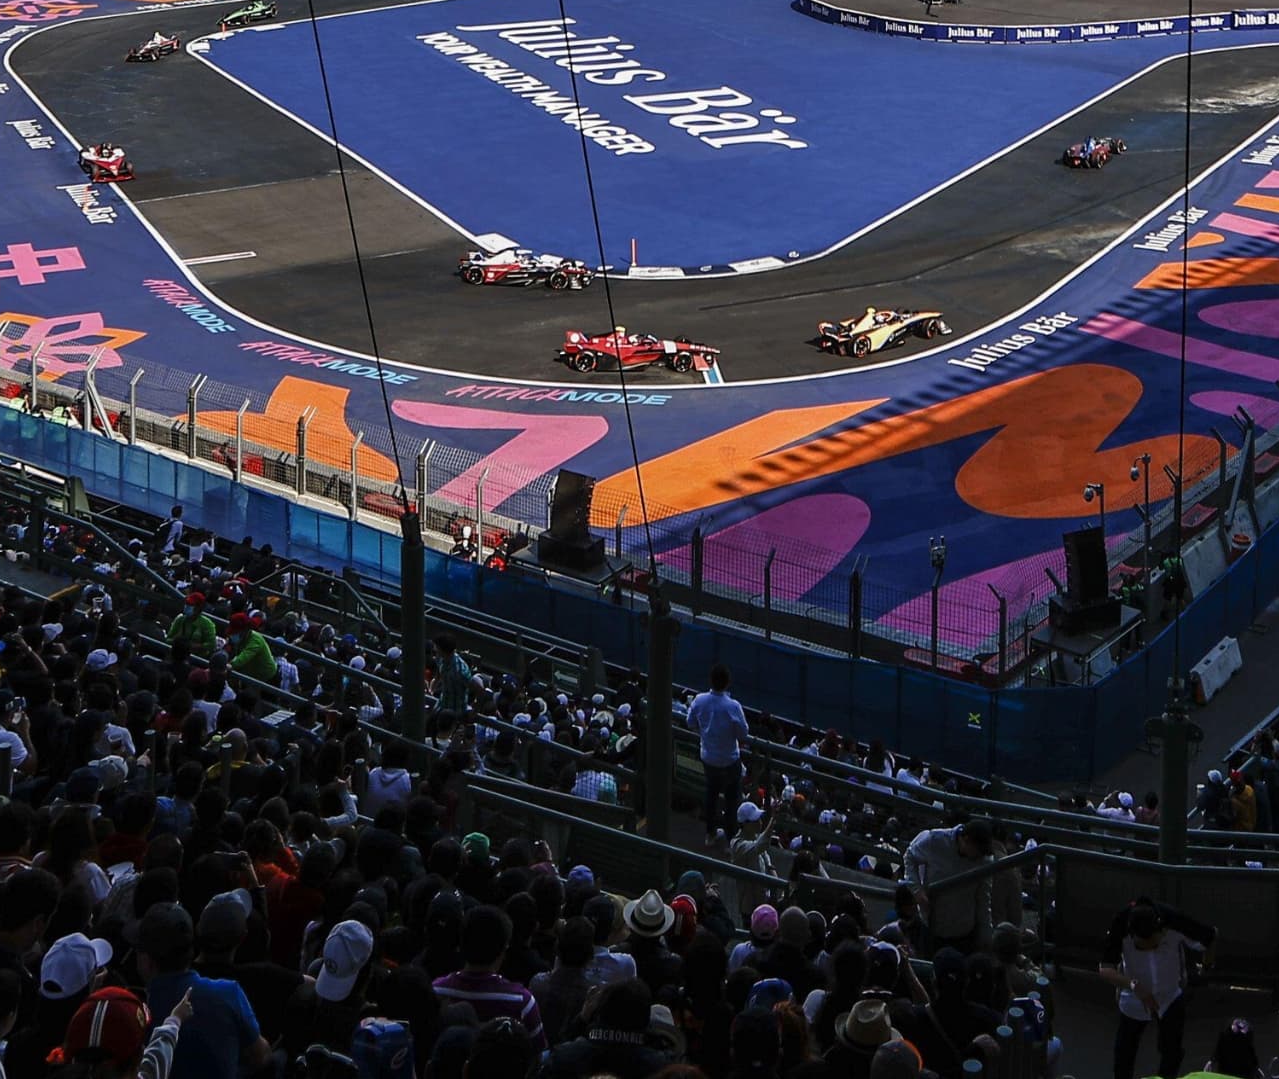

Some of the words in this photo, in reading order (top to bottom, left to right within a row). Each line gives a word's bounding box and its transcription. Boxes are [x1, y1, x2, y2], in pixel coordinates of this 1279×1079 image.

[884, 21, 907, 32] Julius
[908, 23, 924, 33] Bär
[1137, 23, 1158, 33] Julius
[1157, 19, 1174, 29] Bär
[1233, 14, 1265, 26] Julius
[947, 28, 973, 37] Julius
[973, 29, 994, 37] Bär
[1016, 27, 1041, 39] Julius
[1042, 29, 1061, 37] Bär
[1080, 27, 1103, 37] Julius
[1102, 23, 1120, 33] Bär
[455, 17, 666, 85] Julius
[622, 85, 809, 150] Bär
[415, 31, 481, 56] YOUR
[456, 52, 552, 98] WEALTH
[522, 89, 656, 156] MANAGER
[82, 206, 118, 224] Bär
[1132, 224, 1185, 251] Julius
[1168, 207, 1209, 224] Bär
[947, 334, 1036, 371] Julius
[1019, 312, 1079, 335] Bär
